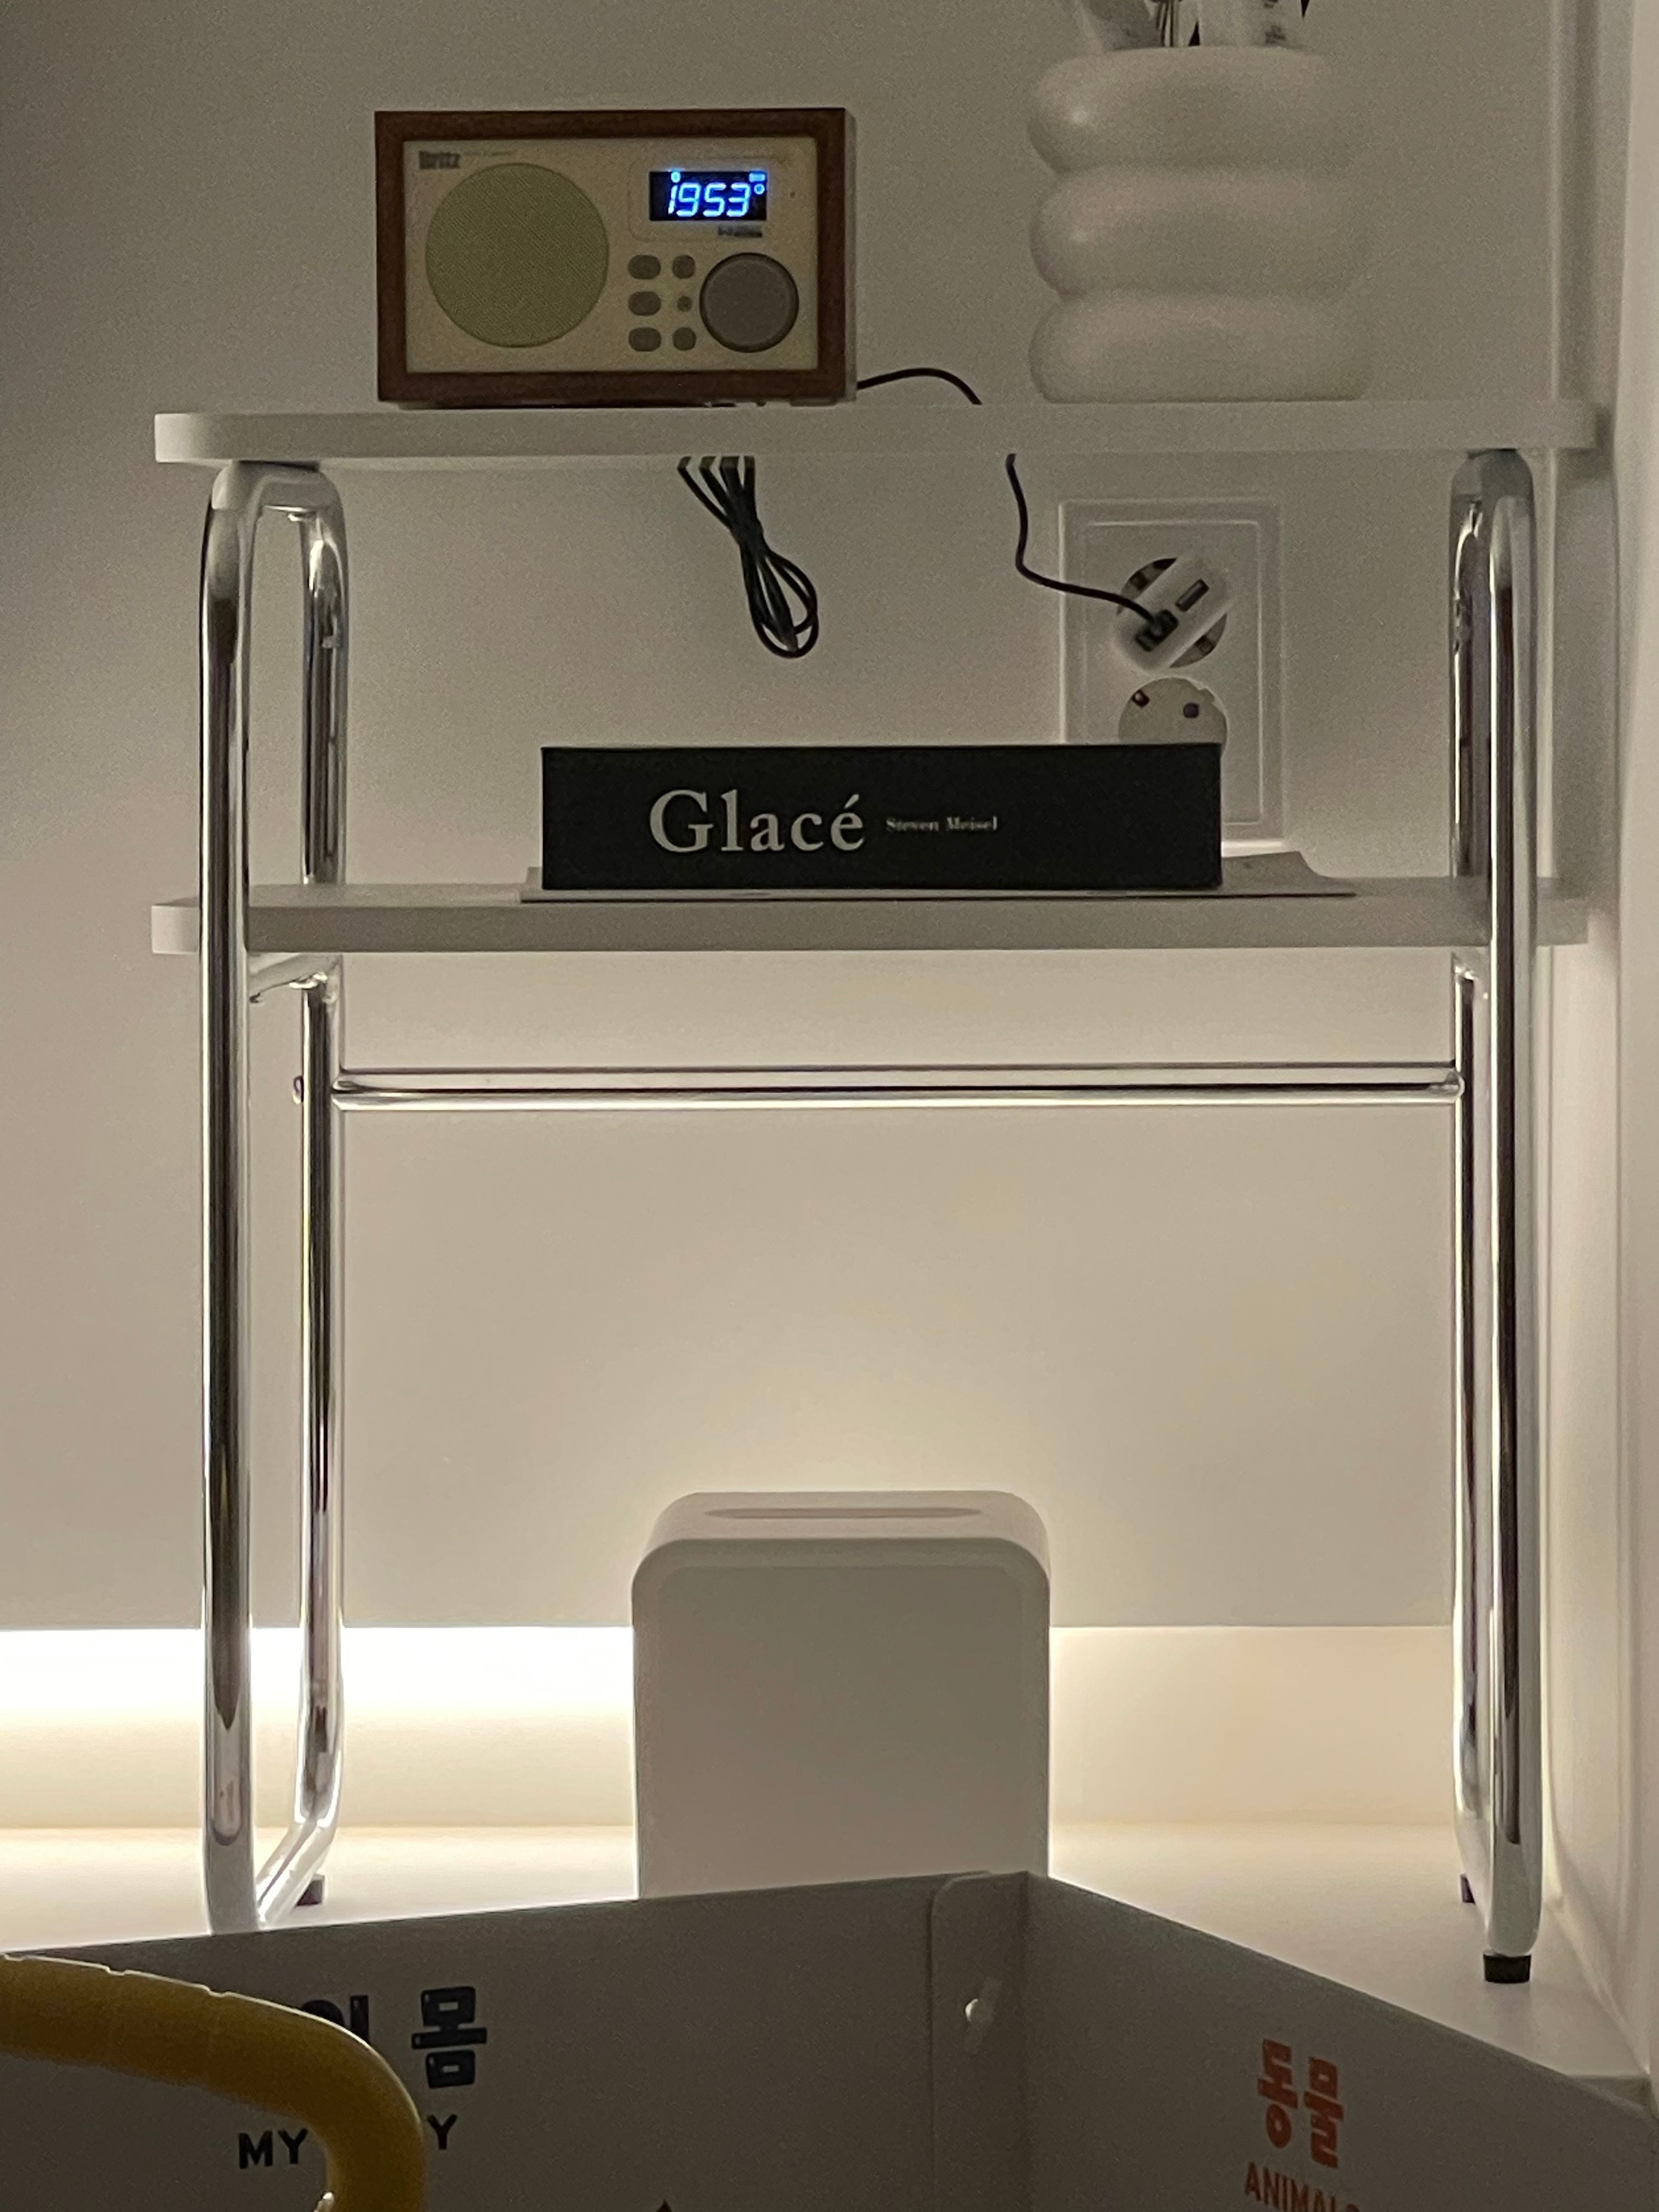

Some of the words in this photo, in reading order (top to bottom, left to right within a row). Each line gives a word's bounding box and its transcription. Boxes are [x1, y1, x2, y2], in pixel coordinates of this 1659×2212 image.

[649, 789, 864, 853] Glacé
[411, 1986, 487, 2089] 몸
[1257, 2038, 1344, 2169] 동물
[238, 2128, 308, 2169] MY
